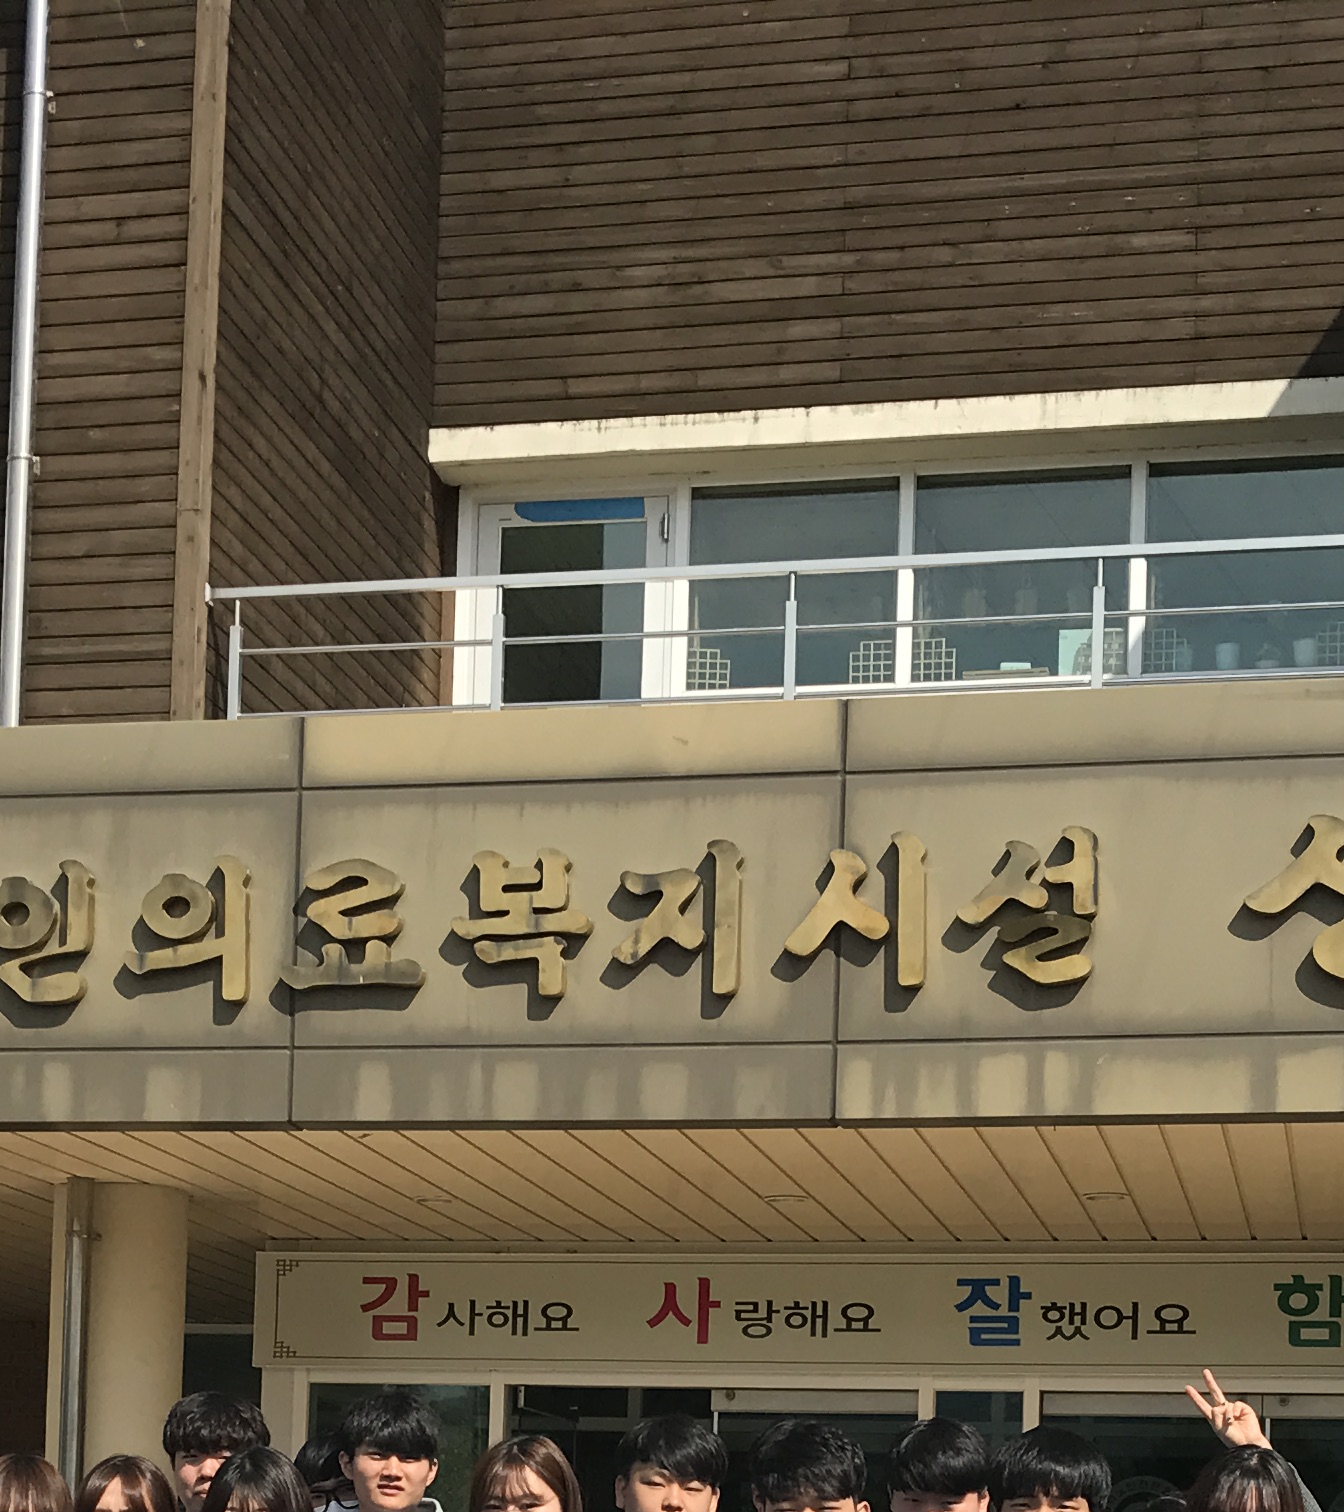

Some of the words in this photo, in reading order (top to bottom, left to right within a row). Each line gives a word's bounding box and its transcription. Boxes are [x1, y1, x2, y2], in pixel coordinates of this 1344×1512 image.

[360, 1272, 580, 1342] 감사해요
[646, 1276, 882, 1345] 사랑해요
[953, 1274, 1197, 1348] 잘했어요
